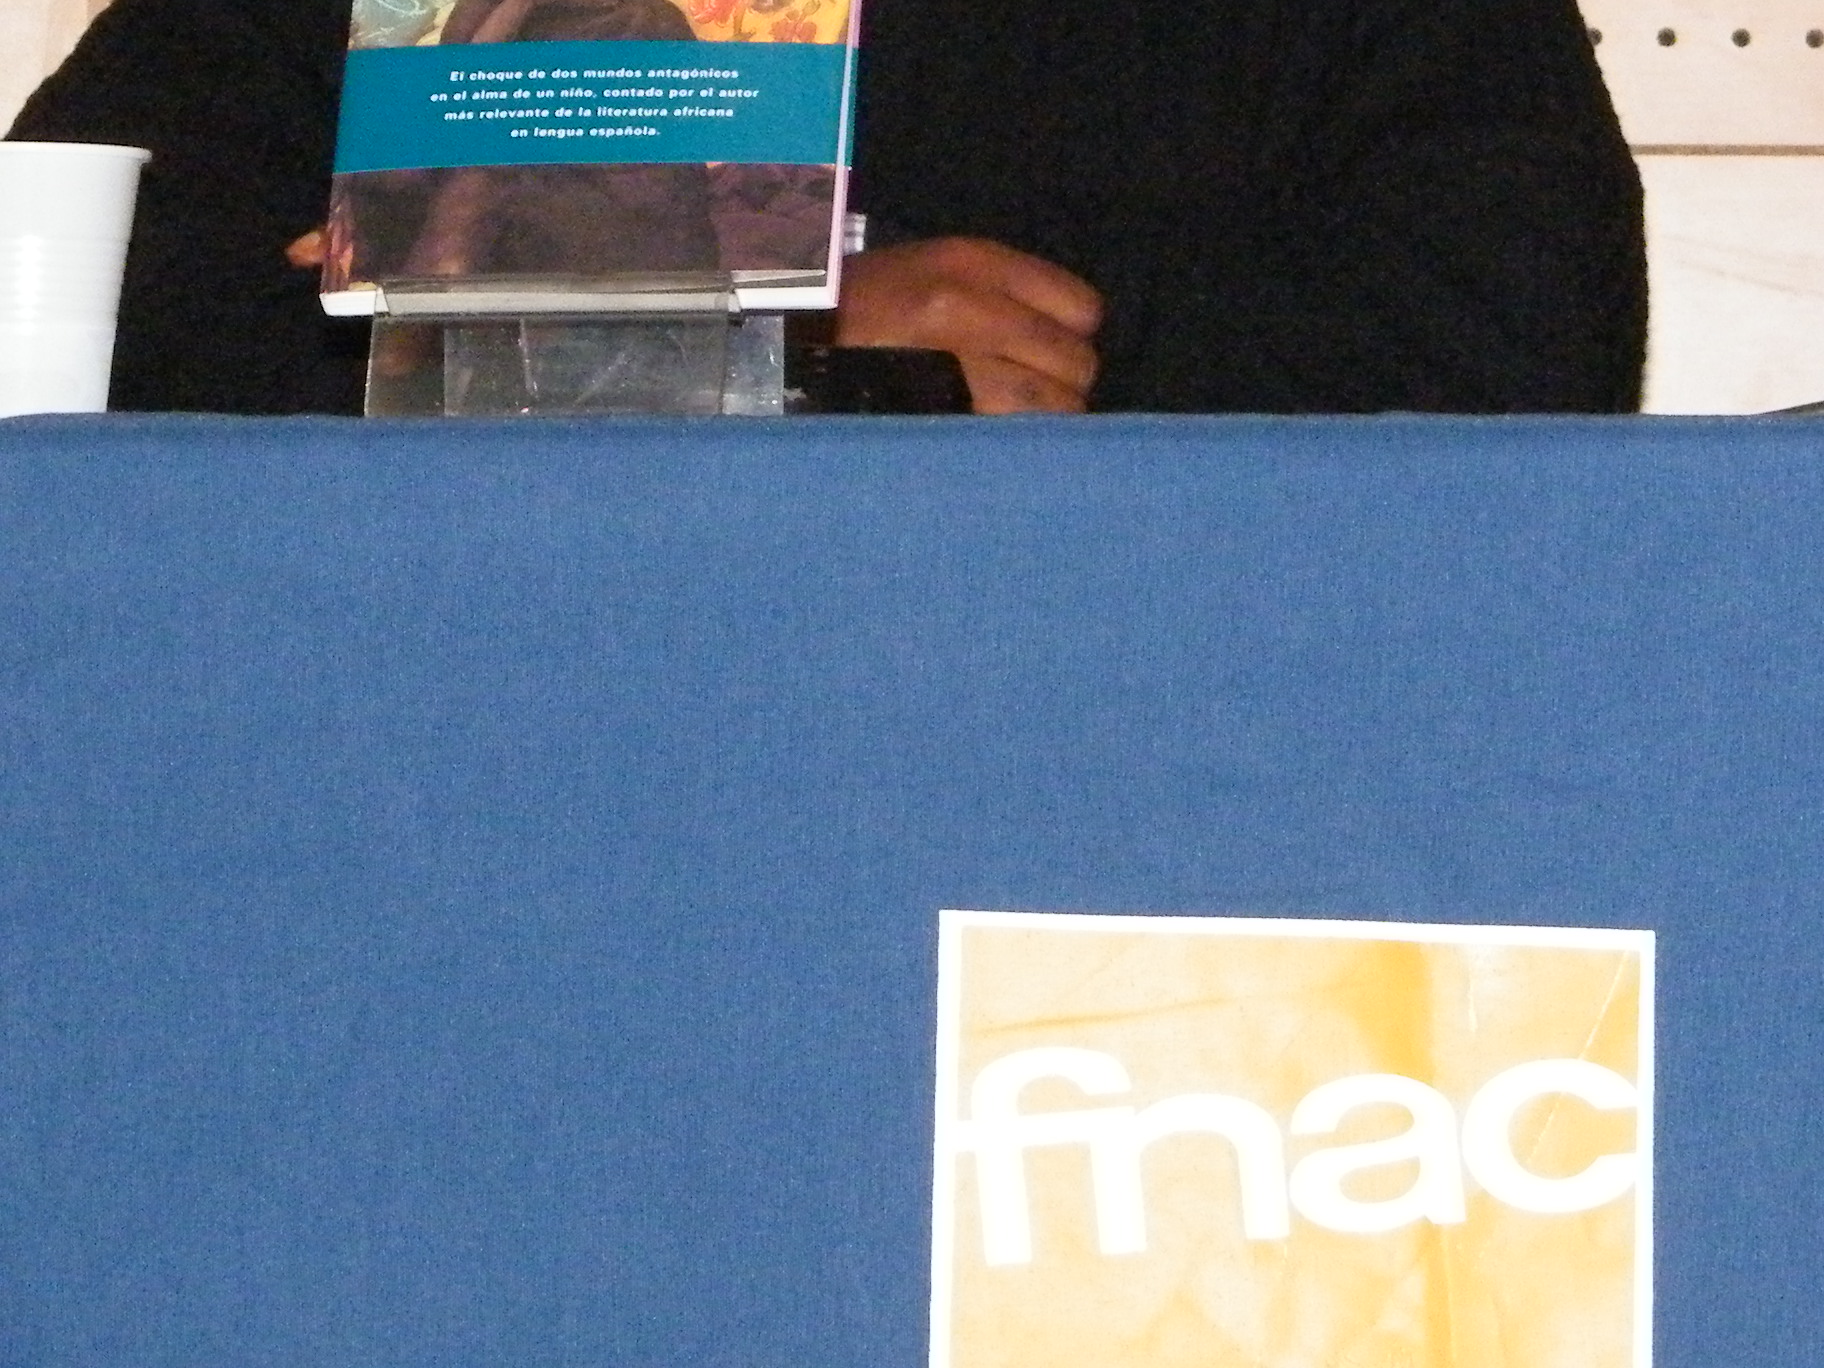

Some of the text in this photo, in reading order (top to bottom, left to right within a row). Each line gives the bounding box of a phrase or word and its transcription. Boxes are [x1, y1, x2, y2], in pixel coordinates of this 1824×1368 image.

[450, 68, 739, 82] El choque de dos mundos antagónicos
[430, 87, 759, 102] en el alma de un niño, contado por el autor
[444, 107, 733, 121] más relevante de la literatura africana
[511, 126, 660, 139] en lengua española.
[938, 1046, 1643, 1267] fnac
